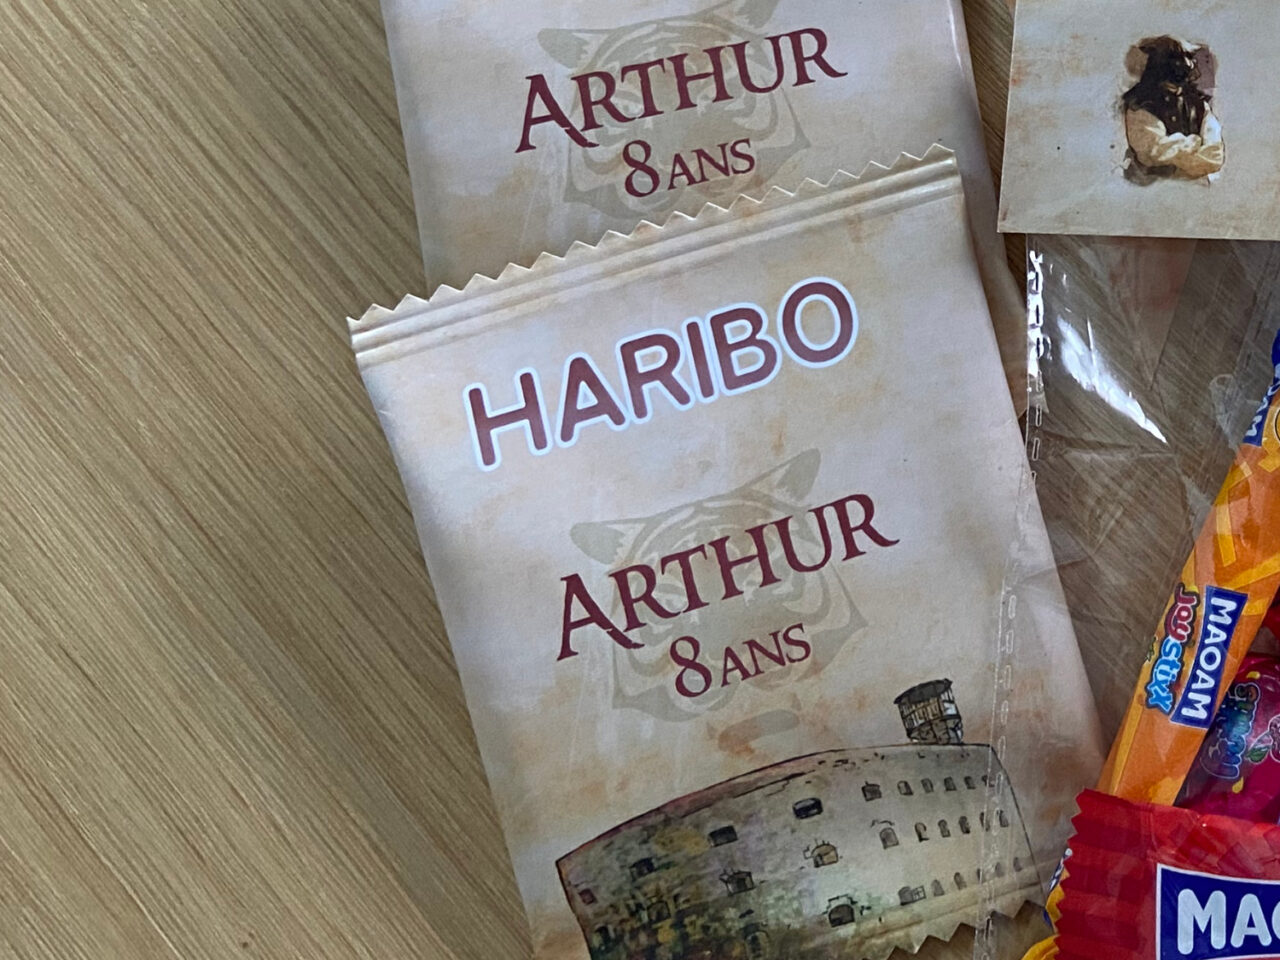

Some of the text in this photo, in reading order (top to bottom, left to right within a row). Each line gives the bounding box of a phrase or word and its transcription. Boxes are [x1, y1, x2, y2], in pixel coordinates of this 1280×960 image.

[515, 27, 850, 155] ARTHUR
[466, 279, 855, 467] HARIBO
[556, 492, 900, 662] ARTHUR
[1181, 597, 1238, 720] MAOAM
